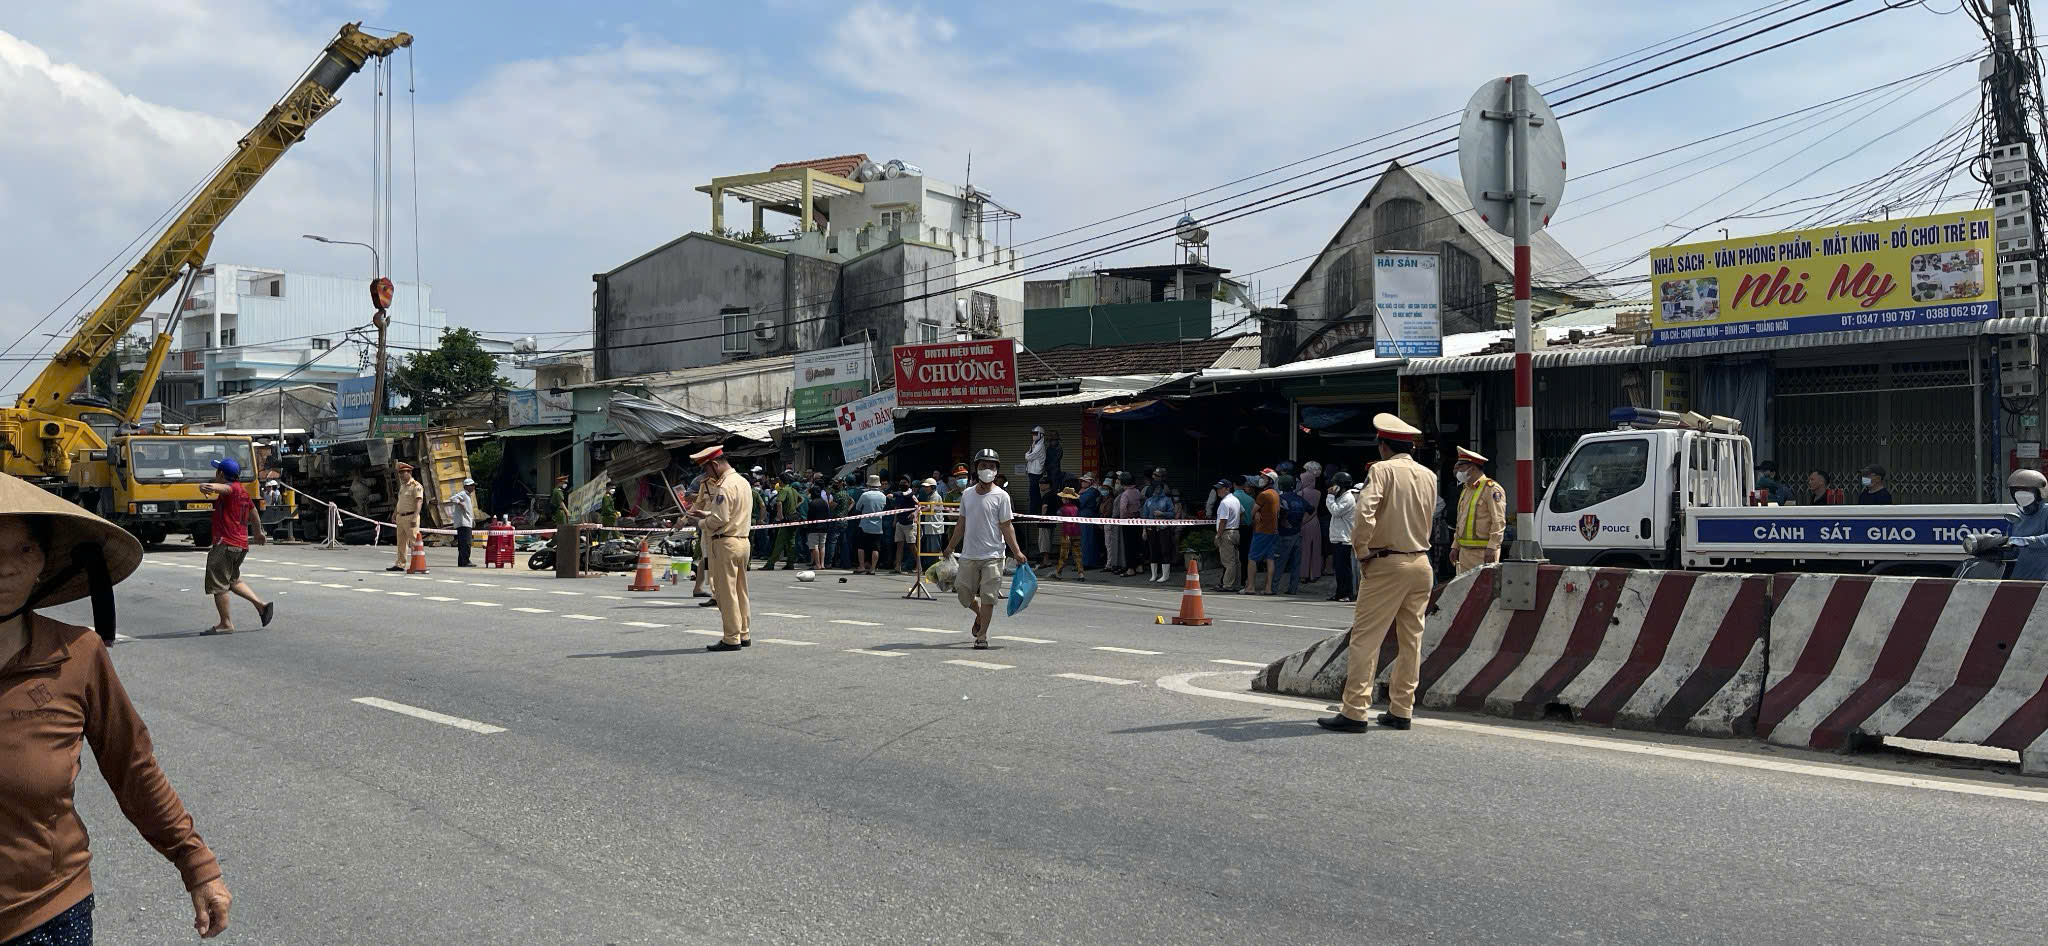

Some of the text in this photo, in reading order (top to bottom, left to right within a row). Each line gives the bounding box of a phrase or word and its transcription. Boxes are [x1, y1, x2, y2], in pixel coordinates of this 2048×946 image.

[1654, 254, 1675, 275] NHÀ
[1677, 252, 1705, 273] SÁCH
[1715, 247, 1736, 268] VĂN
[1738, 243, 1776, 265] PHÒNG
[1779, 235, 1812, 261] PHẨM
[1823, 231, 1848, 256] MẮT
[1851, 231, 1880, 253] KÍNH
[1891, 223, 1908, 249] ĐỒ
[1911, 224, 1940, 247] CHƠI
[1943, 216, 1966, 243] TRẺ
[1969, 220, 1990, 240] EM
[1377, 255, 1418, 268] HẢI SẢN
[1731, 262, 1897, 310] Nhi My
[1841, 315, 1855, 326] ĐT:
[1856, 313, 1879, 324] 0347
[1881, 312, 1898, 322] 190
[1899, 310, 1916, 321] 797
[1926, 307, 1949, 319] 0388
[1950, 305, 1969, 317] 062
[1970, 304, 1989, 316] 972
[1724, 324, 1738, 335] BÌNH
[1738, 323, 1750, 334] SƠN
[1756, 320, 1775, 333] QUẢNG
[1775, 320, 1789, 332] NGÃI
[949, 345, 969, 359] HIỆU
[970, 344, 994, 356] VÀNG
[918, 359, 1007, 383] CHƯƠNG
[341, 388, 375, 409] vinaphon
[874, 407, 893, 426] ĐẶN
[1602, 525, 1631, 533] POLICE
[1753, 522, 1805, 540] CẢNH
[1820, 522, 1852, 540] SÁT
[1867, 527, 1916, 541] GIAO
